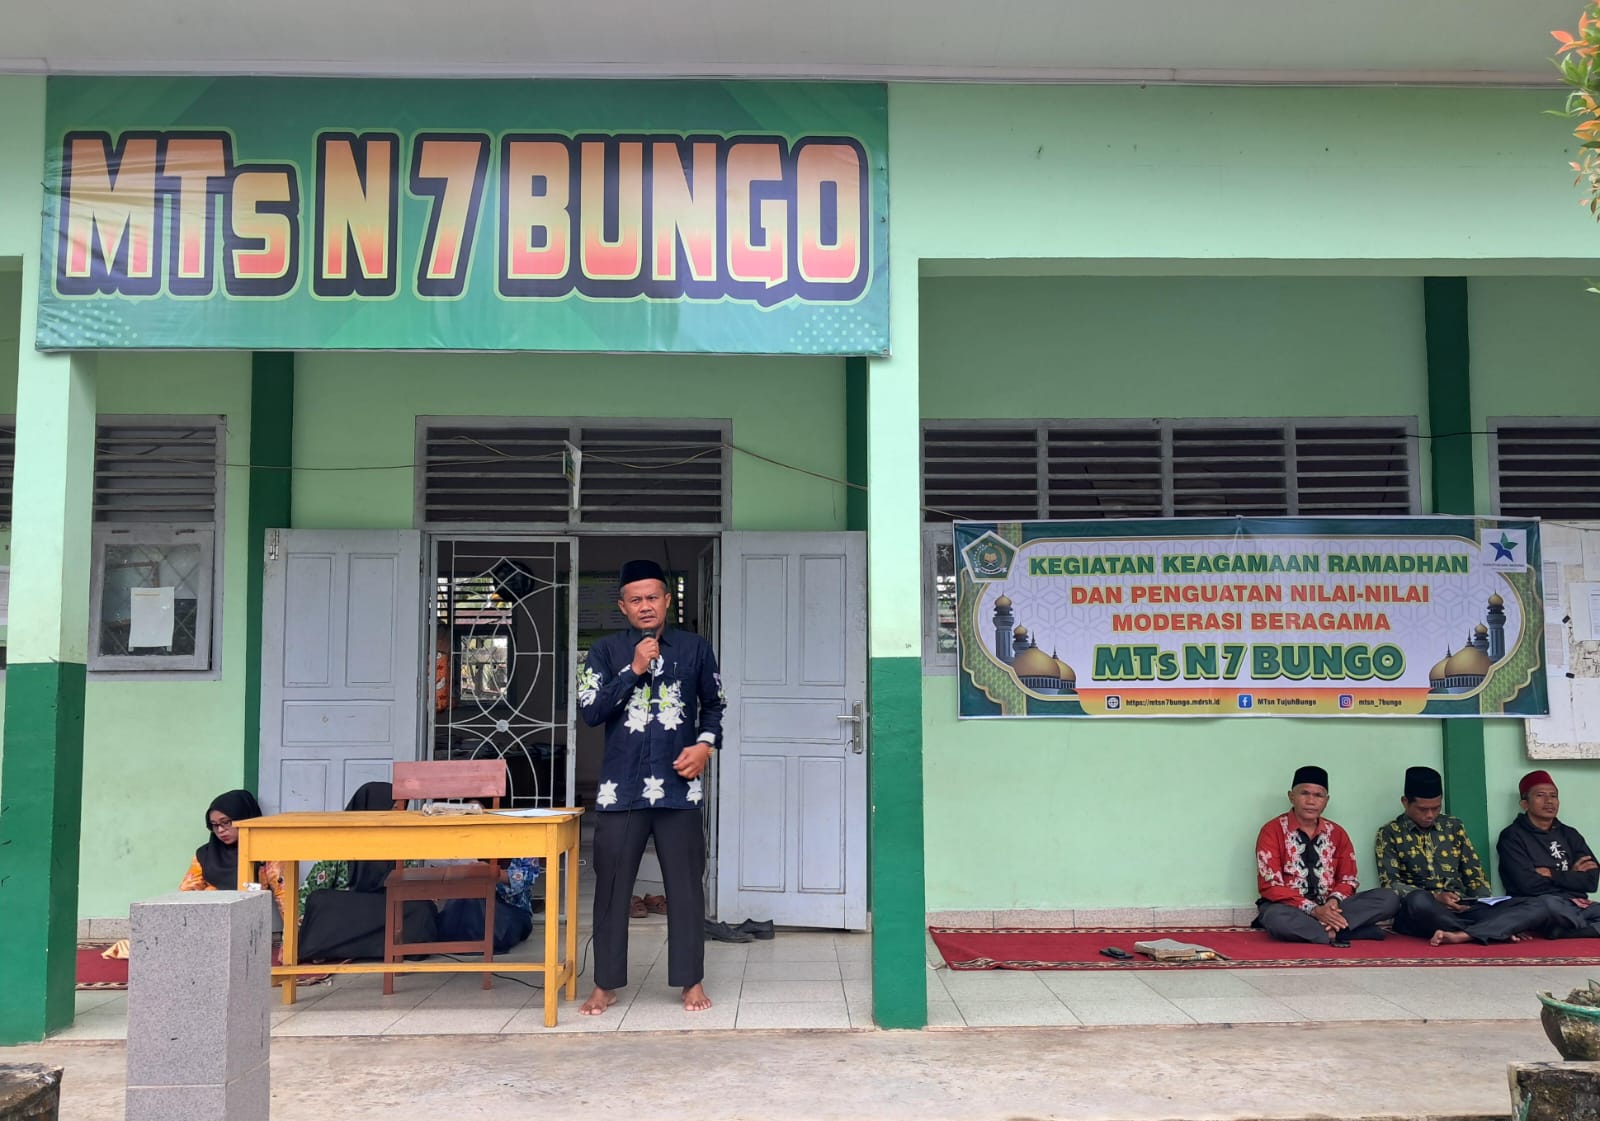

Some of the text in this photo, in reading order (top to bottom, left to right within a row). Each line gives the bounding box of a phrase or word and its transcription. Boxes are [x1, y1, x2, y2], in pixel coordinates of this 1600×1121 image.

[59, 131, 867, 307] MTs N 7 BUNGO
[1029, 554, 1469, 575] KEGIATAN KEAGAMAAN RAMADHAN
[1071, 585, 1430, 604] DAN PENGUATAN NILAI-NILAI
[1113, 613, 1390, 631] MODERASI BERAGAMA
[1093, 645, 1180, 680] MTs
[1251, 643, 1406, 680] BUNGO
